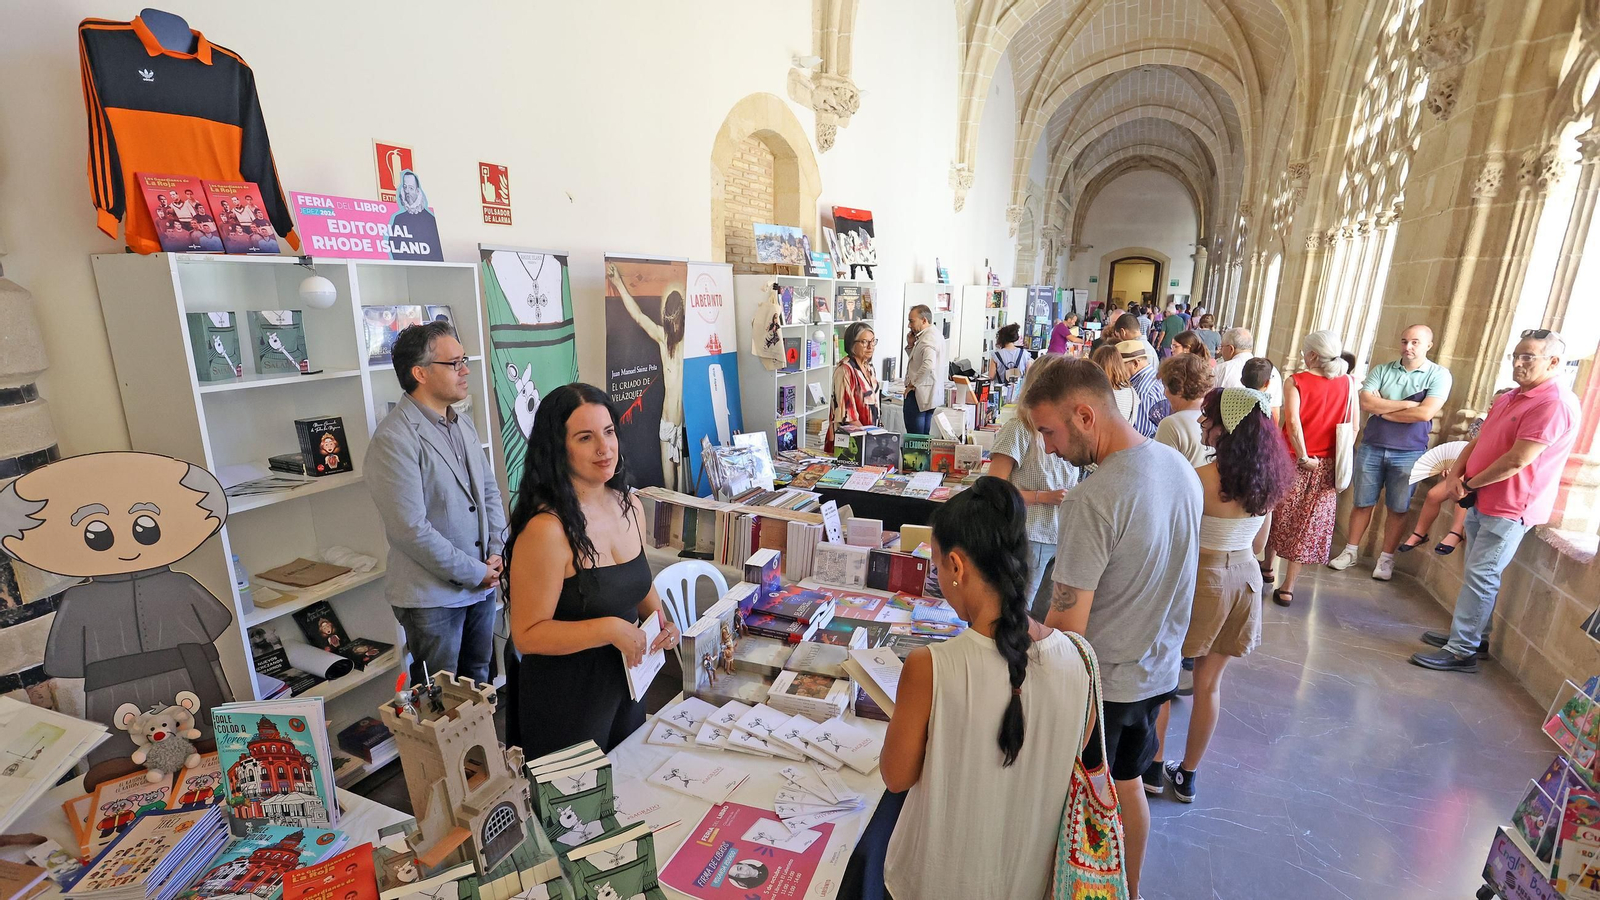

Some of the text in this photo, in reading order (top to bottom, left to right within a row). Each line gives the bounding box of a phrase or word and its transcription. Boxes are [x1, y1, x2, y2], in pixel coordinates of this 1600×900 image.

[297, 195, 387, 214] FERIA DEL LIBRO
[299, 207, 336, 216] JEREZ 2024
[483, 207, 510, 216] PULSADOR
[327, 219, 413, 238] EDITORIAL
[312, 235, 431, 255] RHODE ISLAND
[611, 370, 620, 379] Juan
[621, 367, 636, 376] Manuel
[612, 377, 650, 391] EL CRIADO DE
[612, 389, 643, 402] VELÁZQUEZ
[257, 656, 278, 666] NUEVOS
[800, 643, 821, 667] WANTED
[215, 715, 232, 724] DALE
[217, 725, 247, 733] COLOR A
[220, 733, 248, 745] Jerez
[701, 805, 730, 842] FERIA DEL LIBRO
[697, 841, 731, 888] FIRMA DE LIBROS
[724, 849, 737, 866] ROSADO
[291, 870, 304, 878] Los
[306, 856, 346, 874] Guardianes
[292, 865, 336, 883] La Roja
[783, 858, 794, 876] Laberinto
[766, 883, 774, 891] de
[770, 866, 783, 884] octubre
